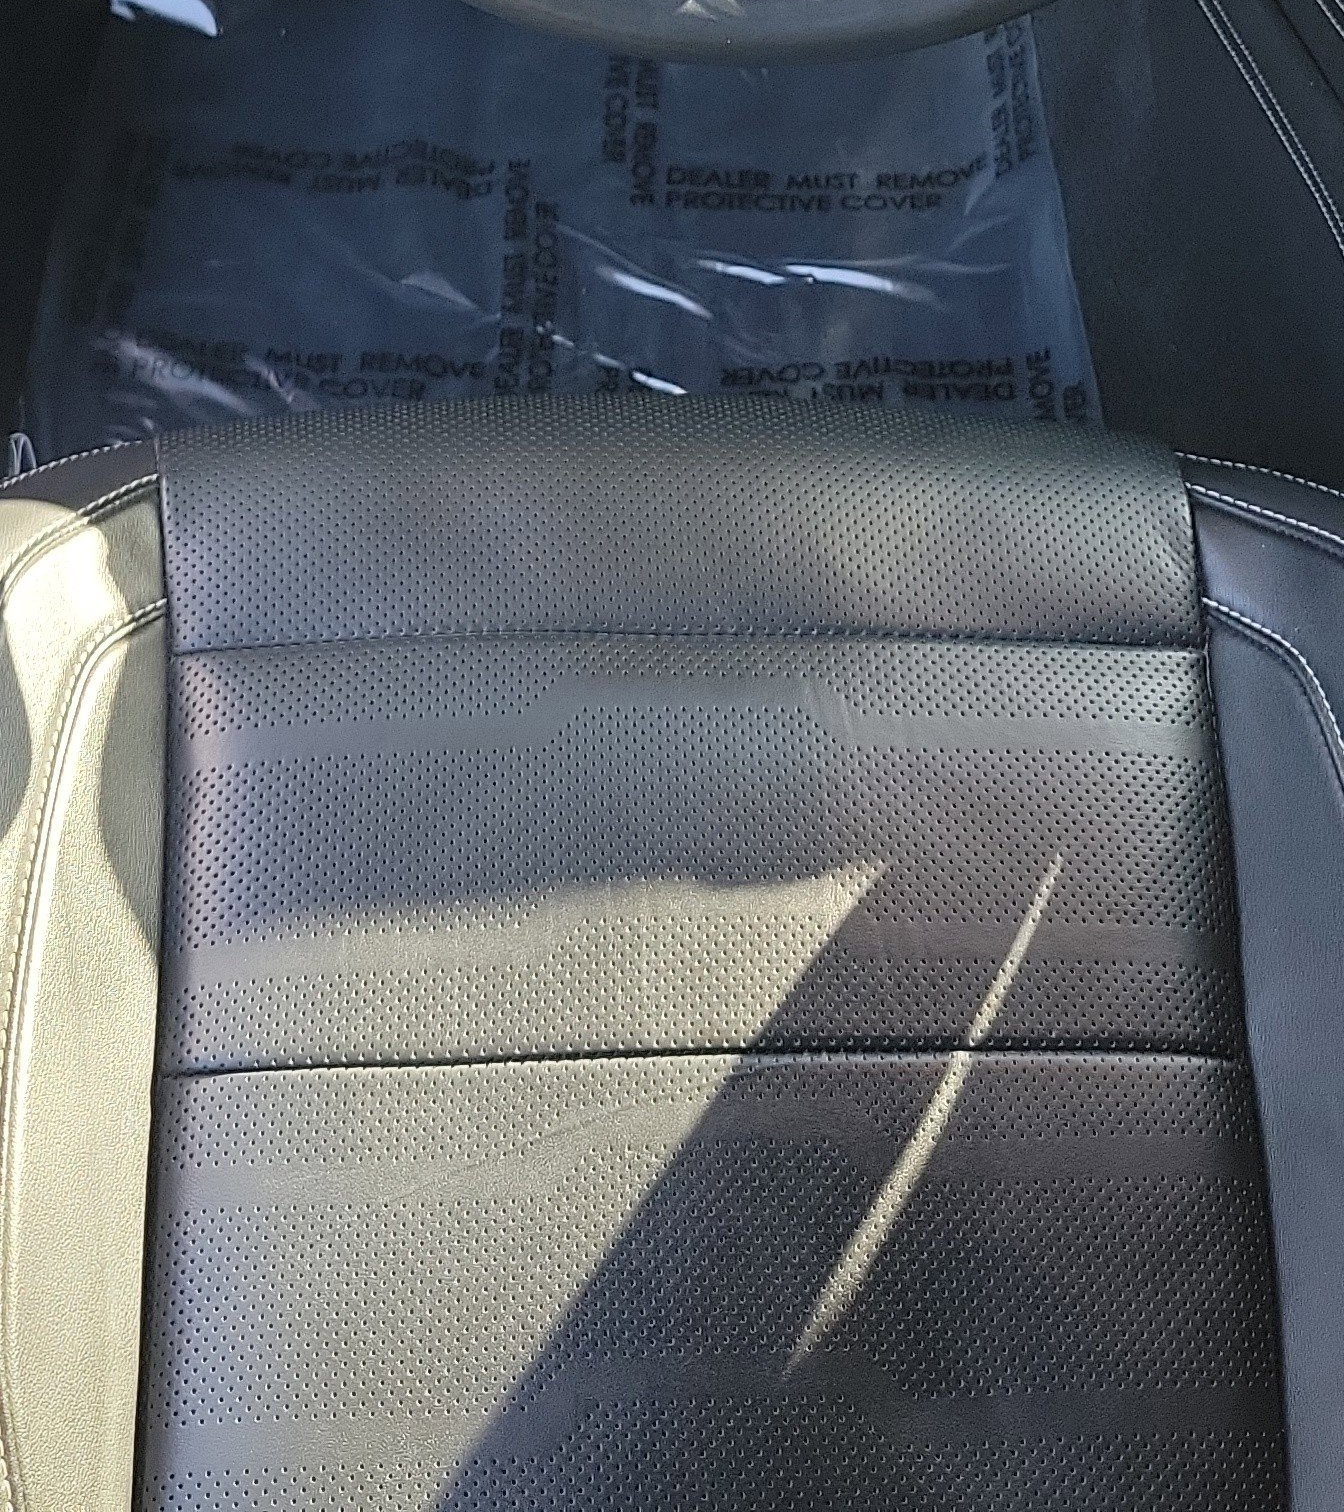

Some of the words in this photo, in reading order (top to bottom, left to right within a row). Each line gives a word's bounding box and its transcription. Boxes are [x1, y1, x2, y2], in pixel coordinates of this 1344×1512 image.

[665, 165, 771, 189] DEALER
[786, 172, 859, 190] MUST
[876, 152, 987, 190] REMOVE
[665, 190, 831, 213] PROTECTIVE
[840, 193, 943, 213] COVER
[264, 346, 345, 374] MUST
[360, 350, 487, 379] REMOVE
[720, 361, 826, 387] COVER
[834, 355, 1014, 383] PROTECTIVE
